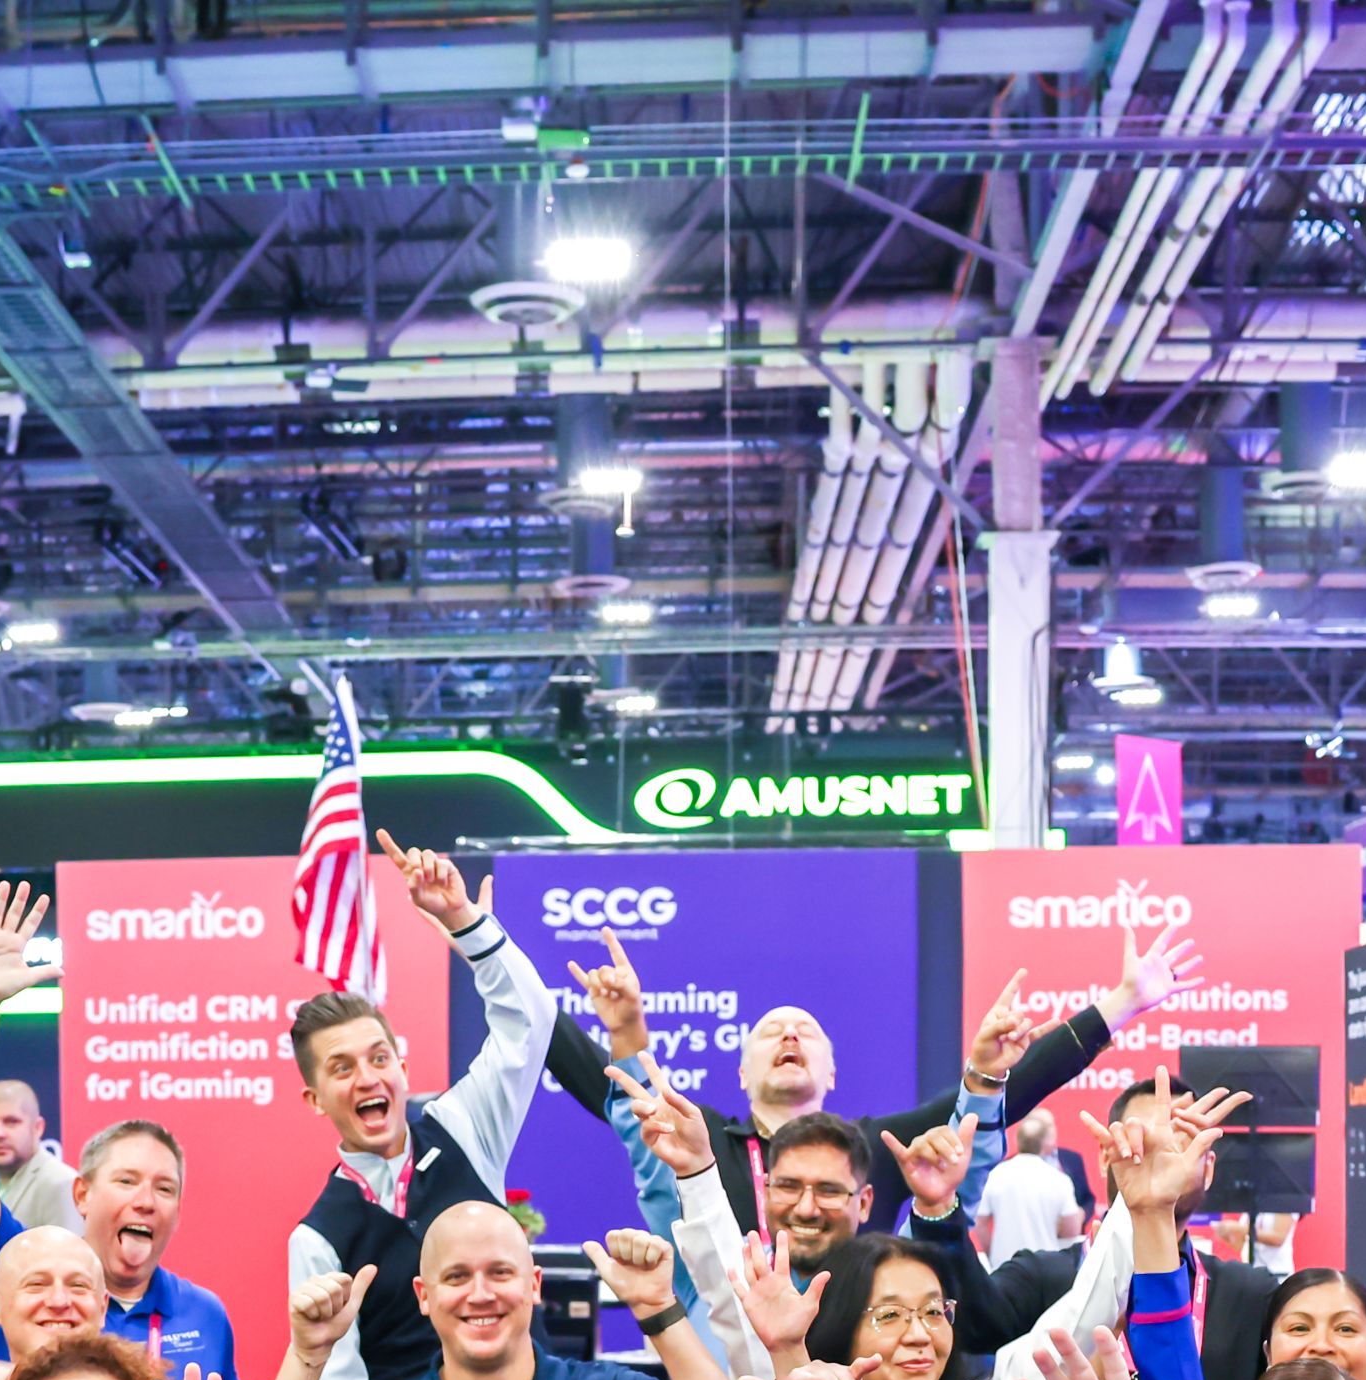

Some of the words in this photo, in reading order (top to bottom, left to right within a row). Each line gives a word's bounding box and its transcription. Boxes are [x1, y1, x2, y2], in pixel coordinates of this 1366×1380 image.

[719, 774, 972, 818] AMUSNET
[86, 891, 264, 941] smartico
[541, 886, 677, 927] SCCG
[1008, 879, 1192, 928] smartico
[85, 995, 197, 1024] Unified
[205, 996, 277, 1022] CRM
[642, 983, 738, 1019] aming
[1011, 984, 1111, 1018] Loyalt
[1149, 982, 1288, 1012] olutions
[85, 1032, 269, 1063] Gamifiction
[85, 1073, 130, 1101] for
[139, 1069, 274, 1105] iGaming
